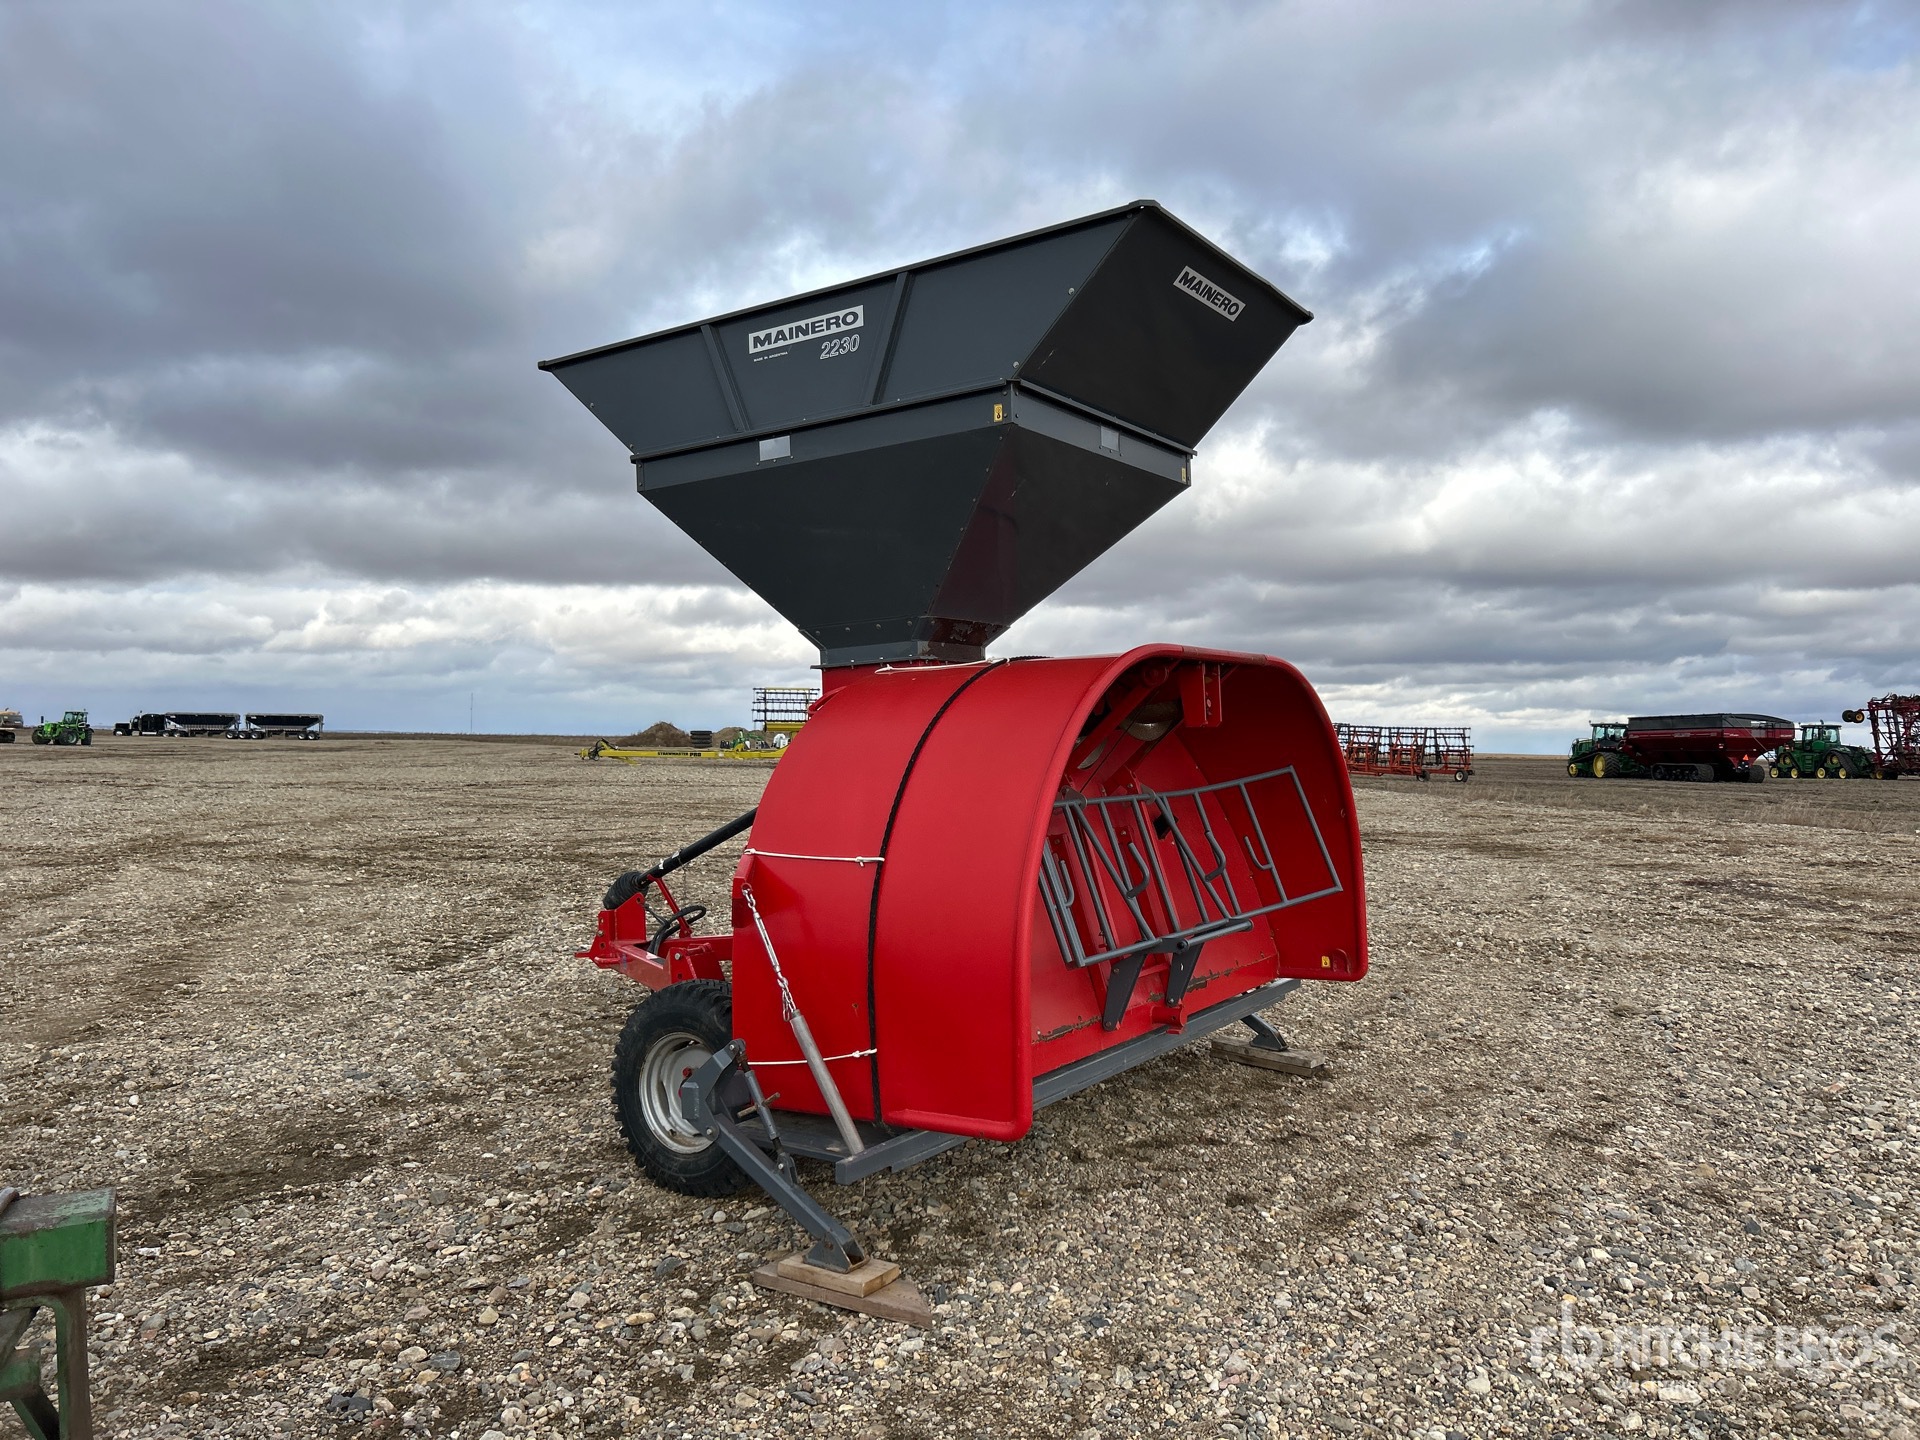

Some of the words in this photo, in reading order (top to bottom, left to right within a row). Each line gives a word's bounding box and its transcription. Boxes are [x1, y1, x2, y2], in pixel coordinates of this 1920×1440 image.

[1178, 270, 1240, 316] MAINERO
[752, 311, 859, 349] MAINERO
[820, 334, 860, 360] 2230
